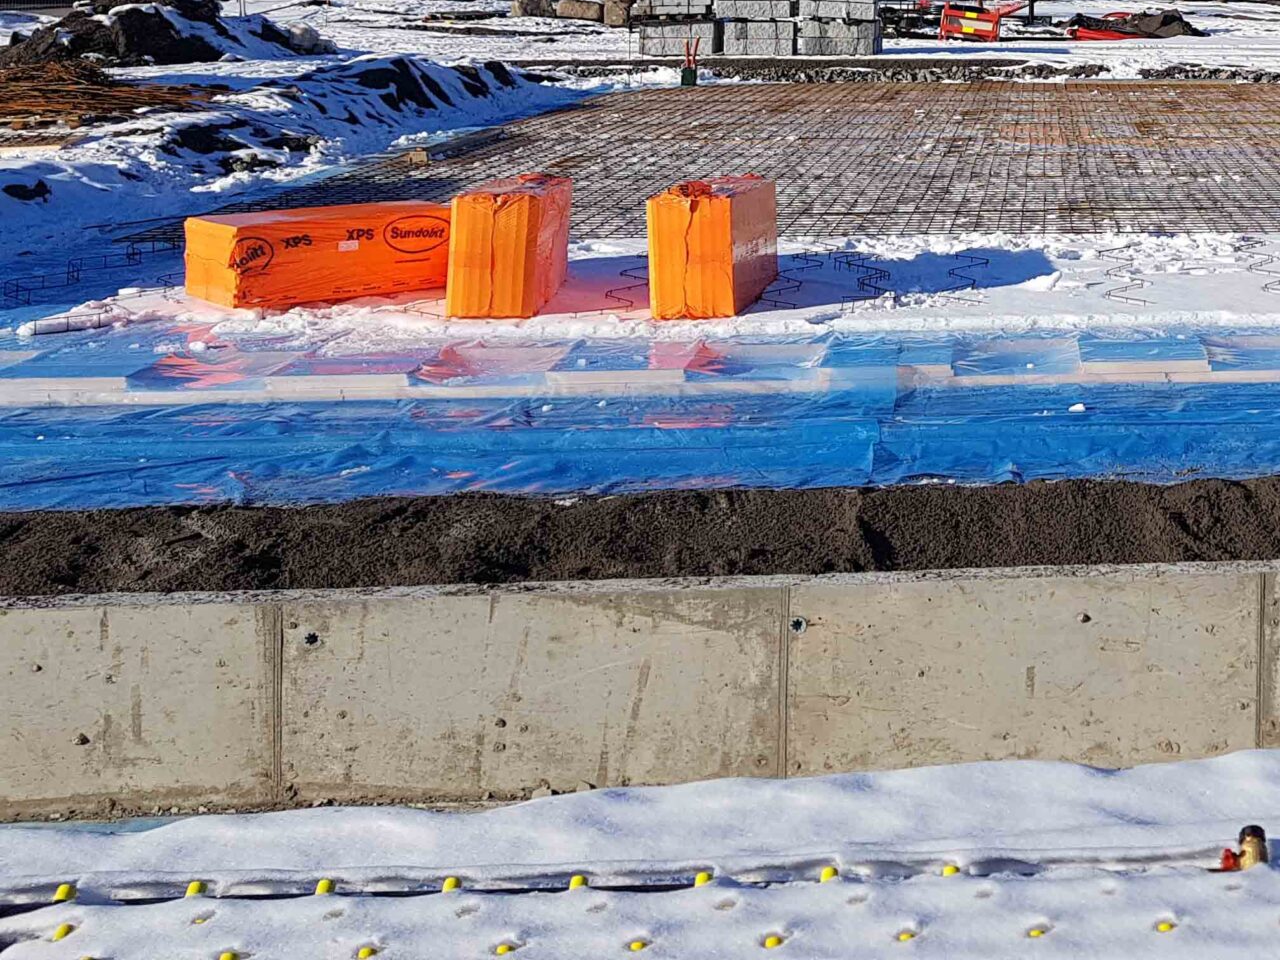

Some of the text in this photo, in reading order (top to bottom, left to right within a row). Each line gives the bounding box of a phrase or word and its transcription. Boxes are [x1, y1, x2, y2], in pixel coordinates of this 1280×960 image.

[283, 234, 313, 249] XPS
[346, 228, 375, 241] XPS
[390, 227, 445, 240] Sundolitt
